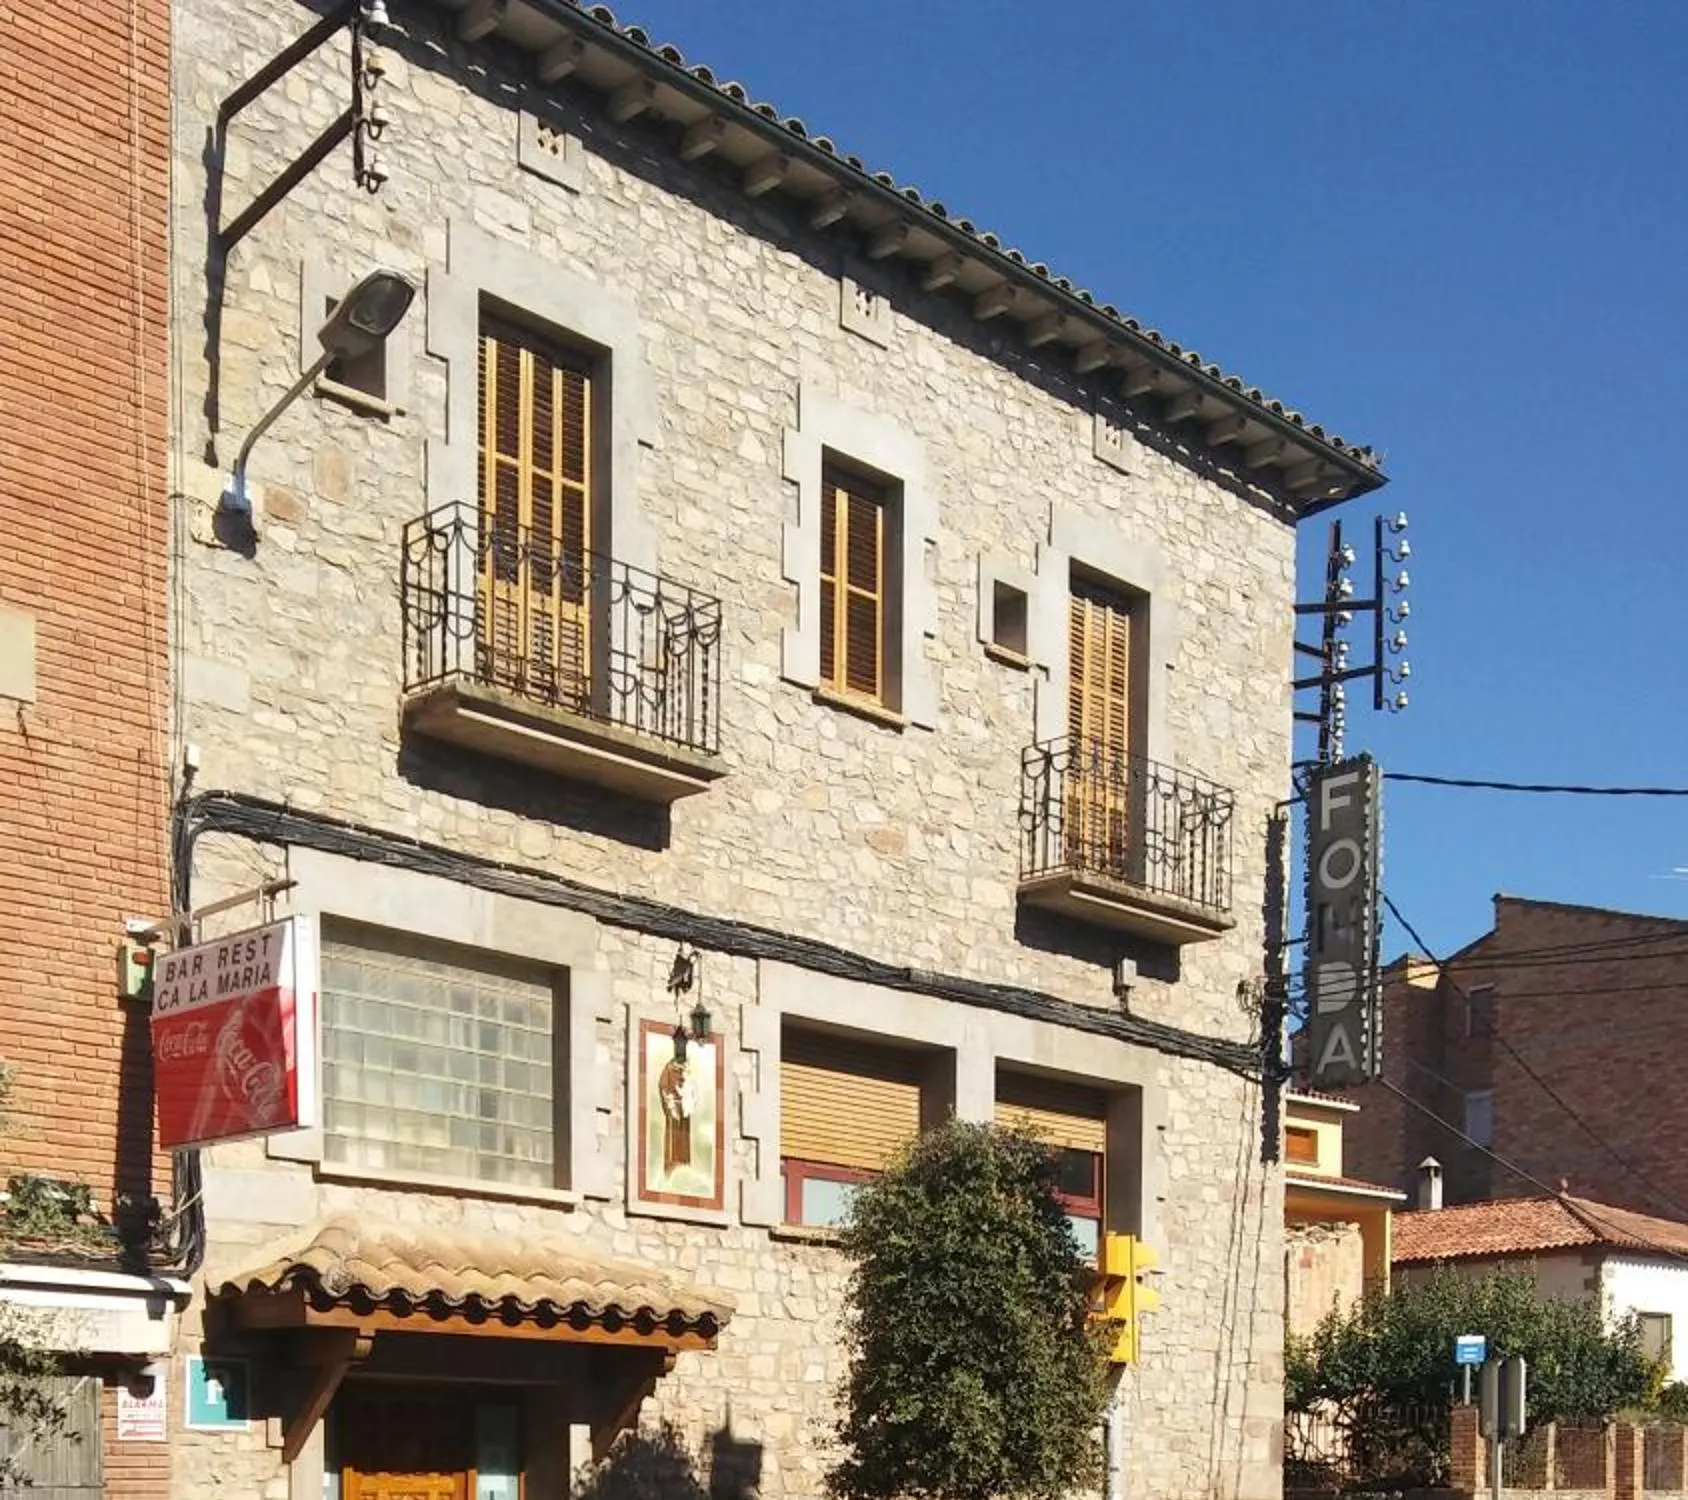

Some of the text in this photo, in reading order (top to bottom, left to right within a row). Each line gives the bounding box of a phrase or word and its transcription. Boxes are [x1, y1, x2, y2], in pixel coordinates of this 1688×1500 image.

[1317, 771, 1361, 1076] FODA
[165, 935, 272, 982] BAR REST
[158, 962, 271, 1011] CA LA MARIA
